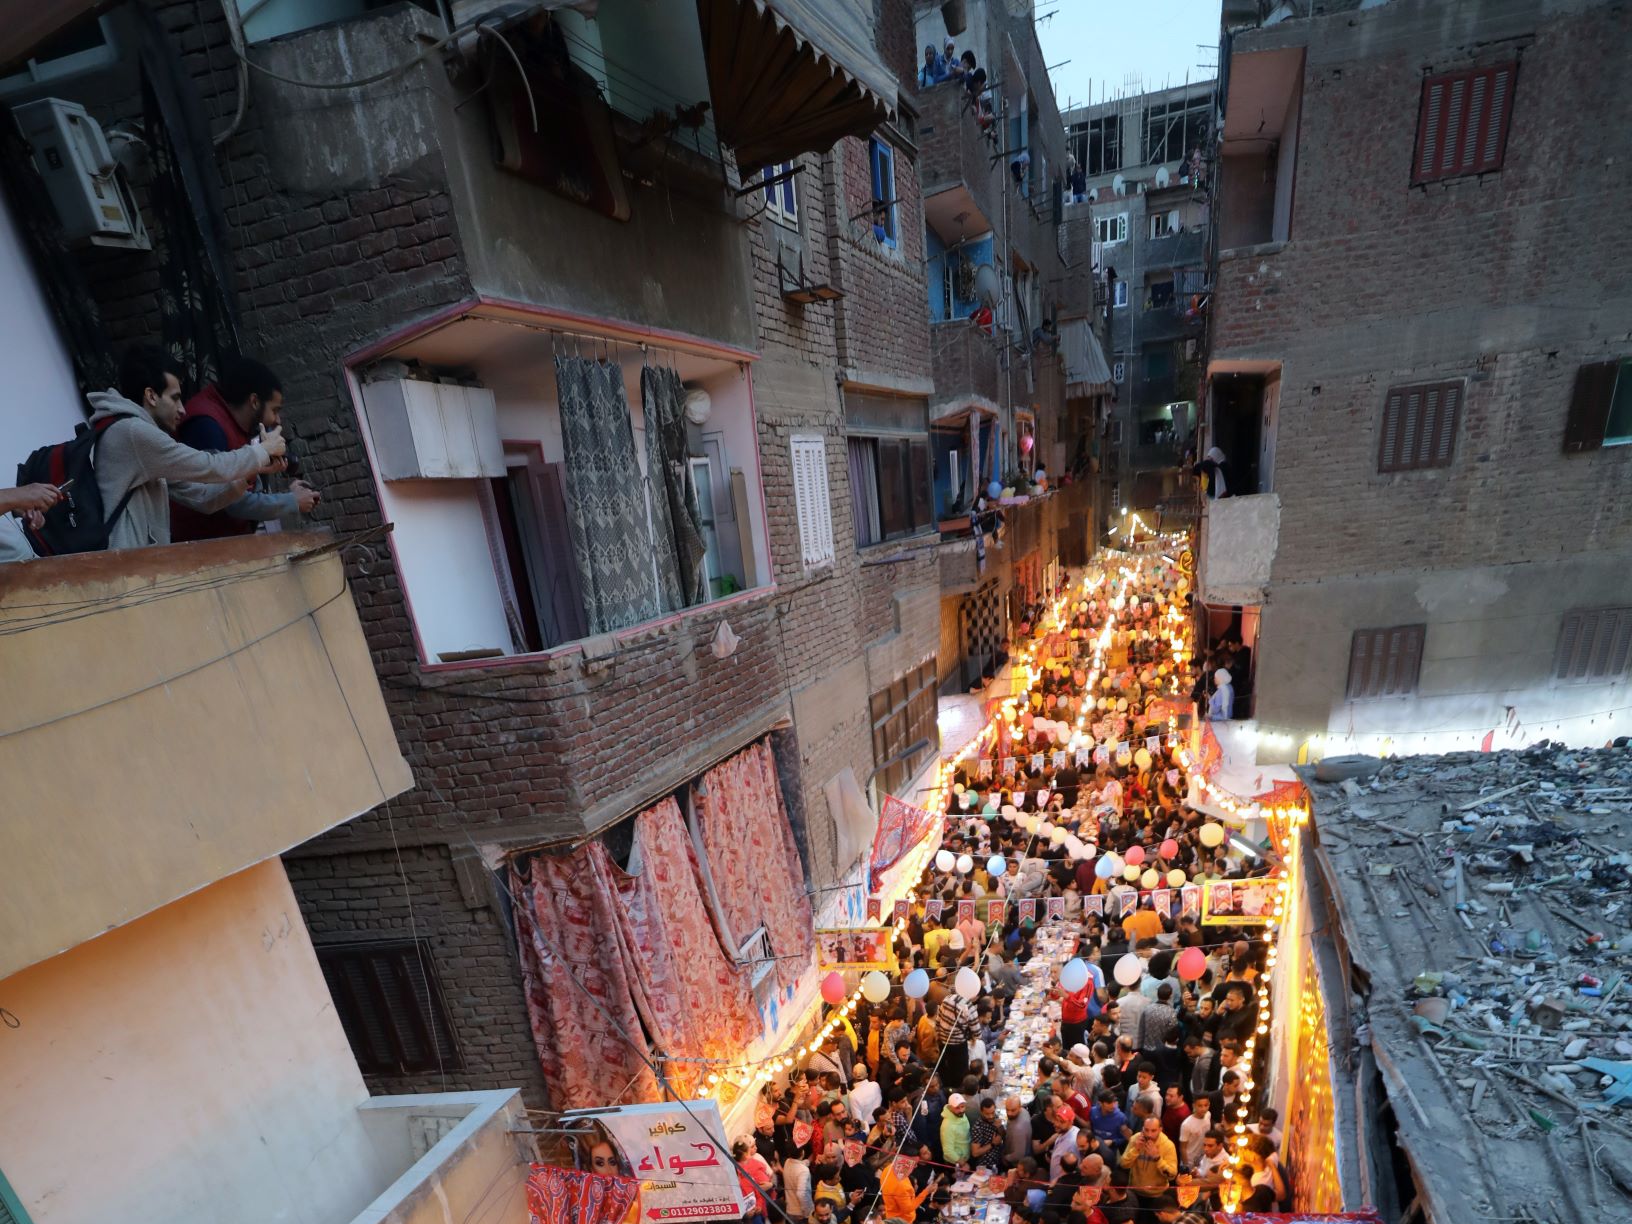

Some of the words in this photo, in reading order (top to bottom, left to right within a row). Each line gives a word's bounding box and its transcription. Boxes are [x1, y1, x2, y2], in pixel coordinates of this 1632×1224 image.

[648, 1121, 687, 1137] كوافير
[637, 1142, 721, 1175] حواء
[643, 1180, 677, 1192] للسيدات
[670, 1204, 733, 1217] 01129023803
